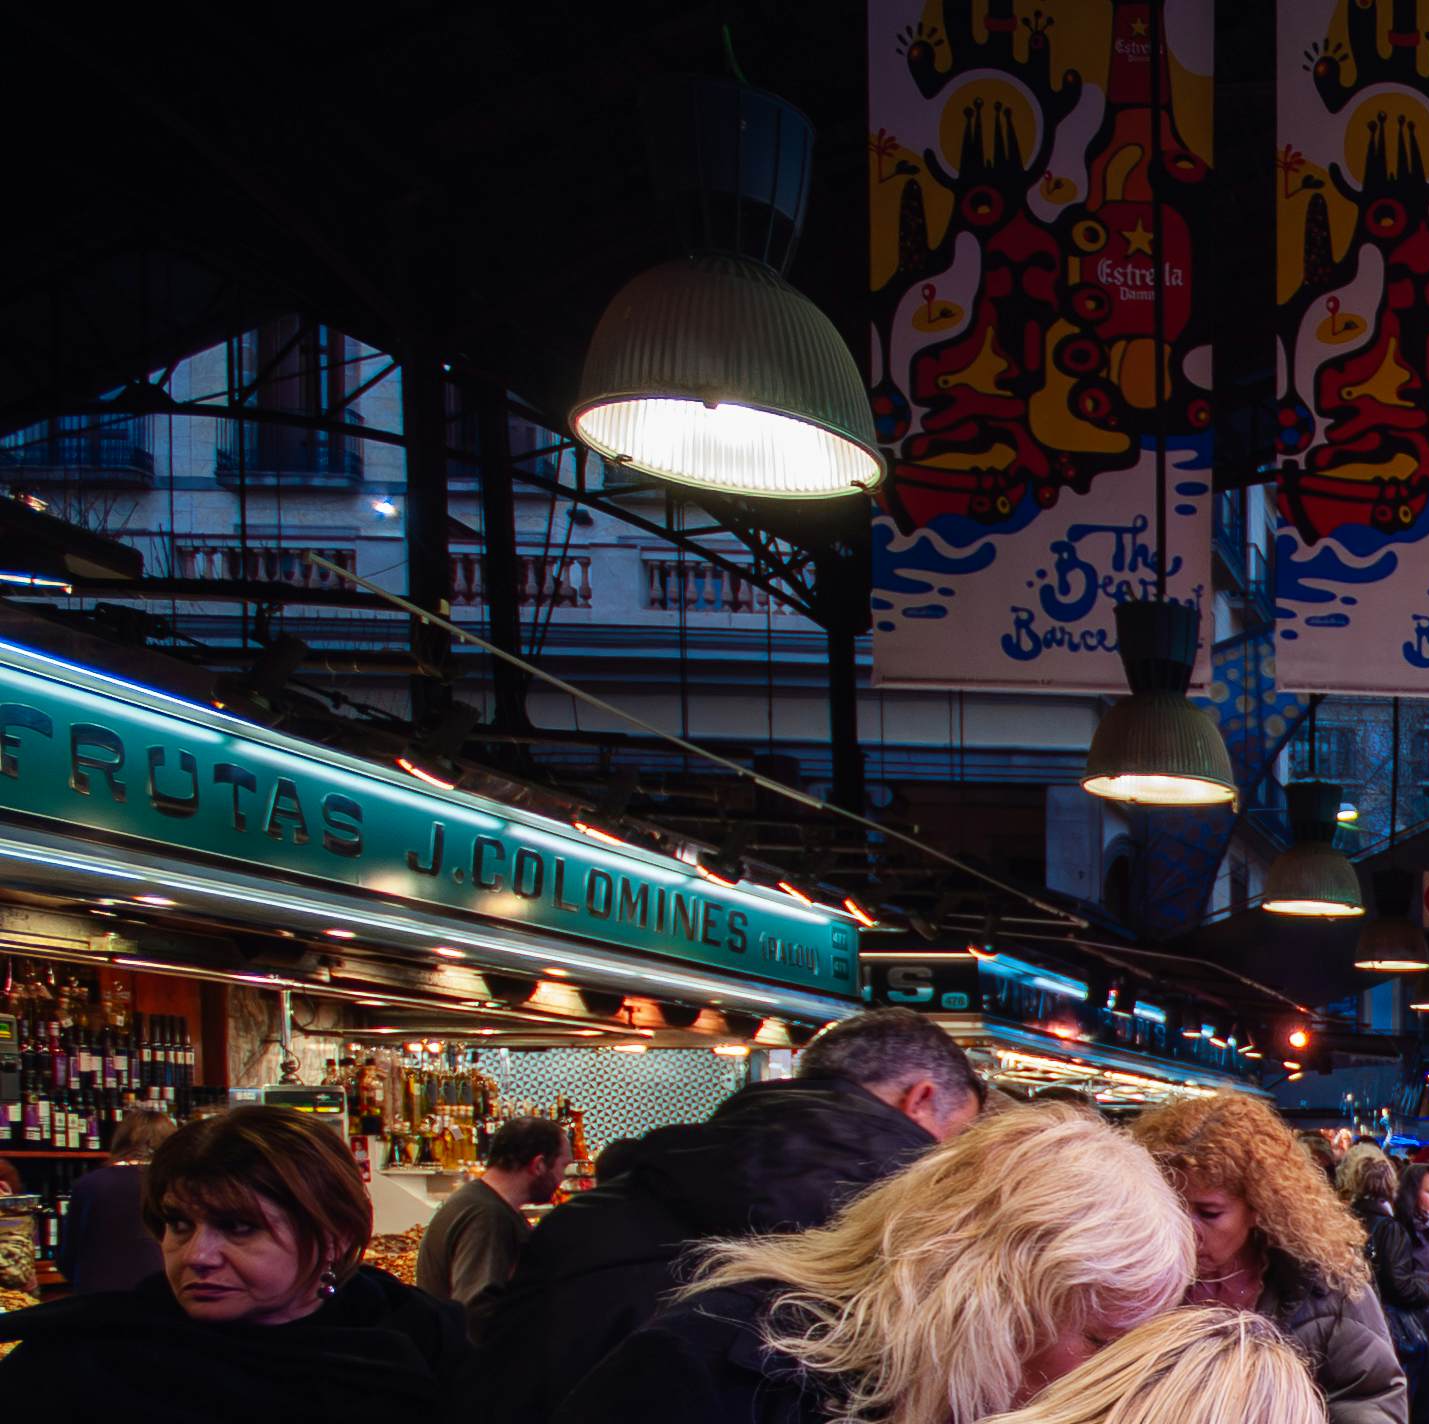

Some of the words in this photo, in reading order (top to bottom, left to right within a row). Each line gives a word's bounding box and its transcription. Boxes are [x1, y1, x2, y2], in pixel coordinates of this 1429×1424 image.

[1097, 257, 1184, 287] Estrela
[0, 702, 364, 858] FRUTAS
[405, 819, 749, 954] J.COLOMINES
